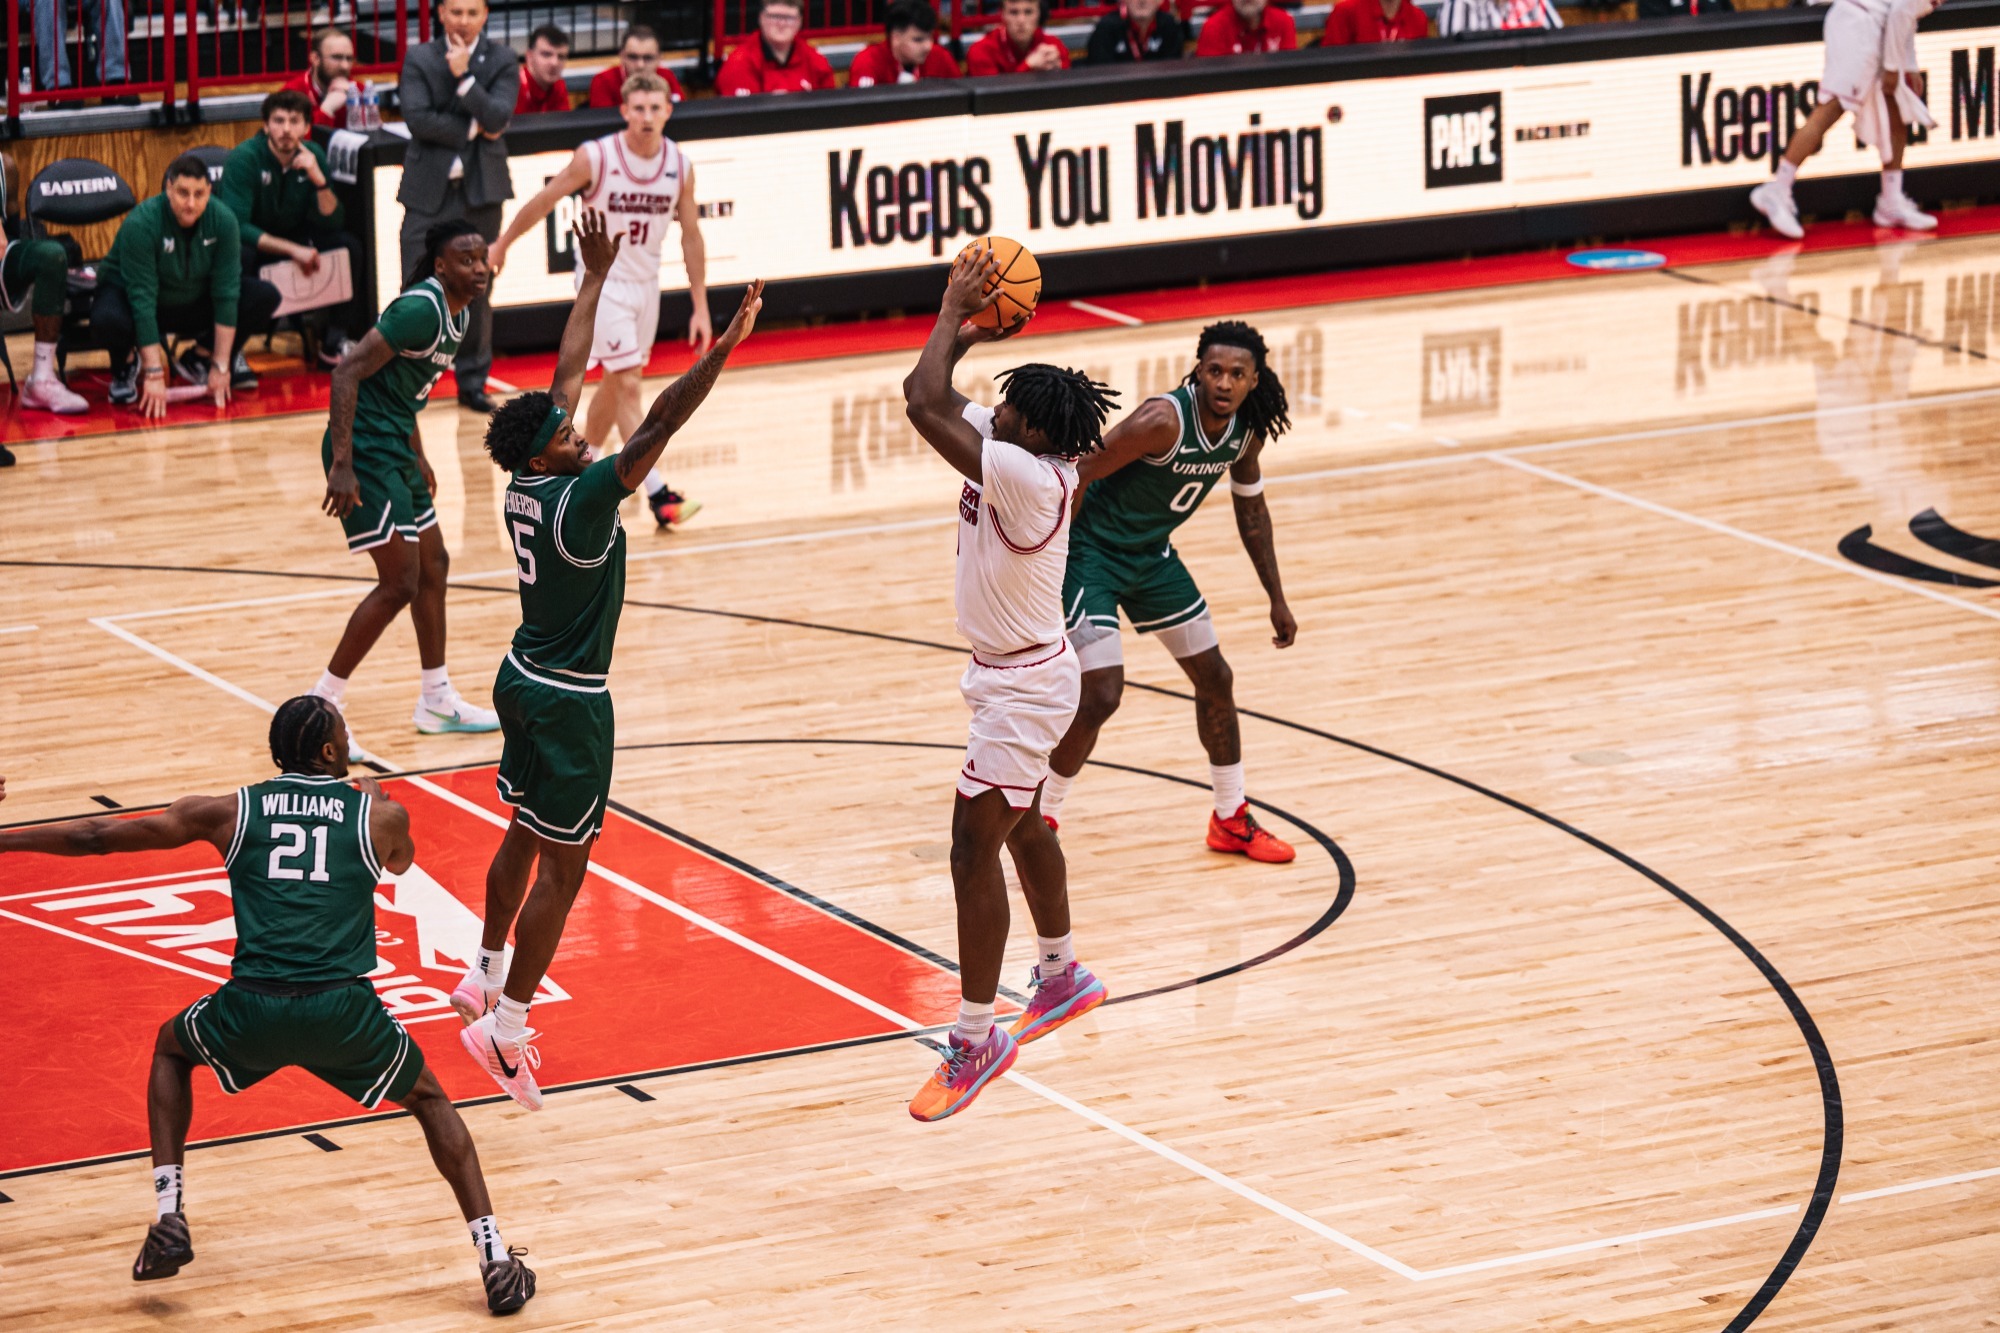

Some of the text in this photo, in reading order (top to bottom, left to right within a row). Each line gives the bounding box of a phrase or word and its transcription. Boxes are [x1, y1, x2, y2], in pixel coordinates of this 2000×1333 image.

[40, 176, 117, 196] EASTERN
[608, 191, 672, 204] EASTERN
[827, 112, 1323, 256] Keeps You Moving
[629, 221, 649, 246] 21
[1172, 460, 1233, 475] VIKINGS
[505, 490, 543, 524] ENDERSON
[1169, 481, 1204, 513] 0
[512, 520, 537, 585] 5
[262, 792, 345, 823] WILLIAMS
[267, 823, 330, 882] 21
